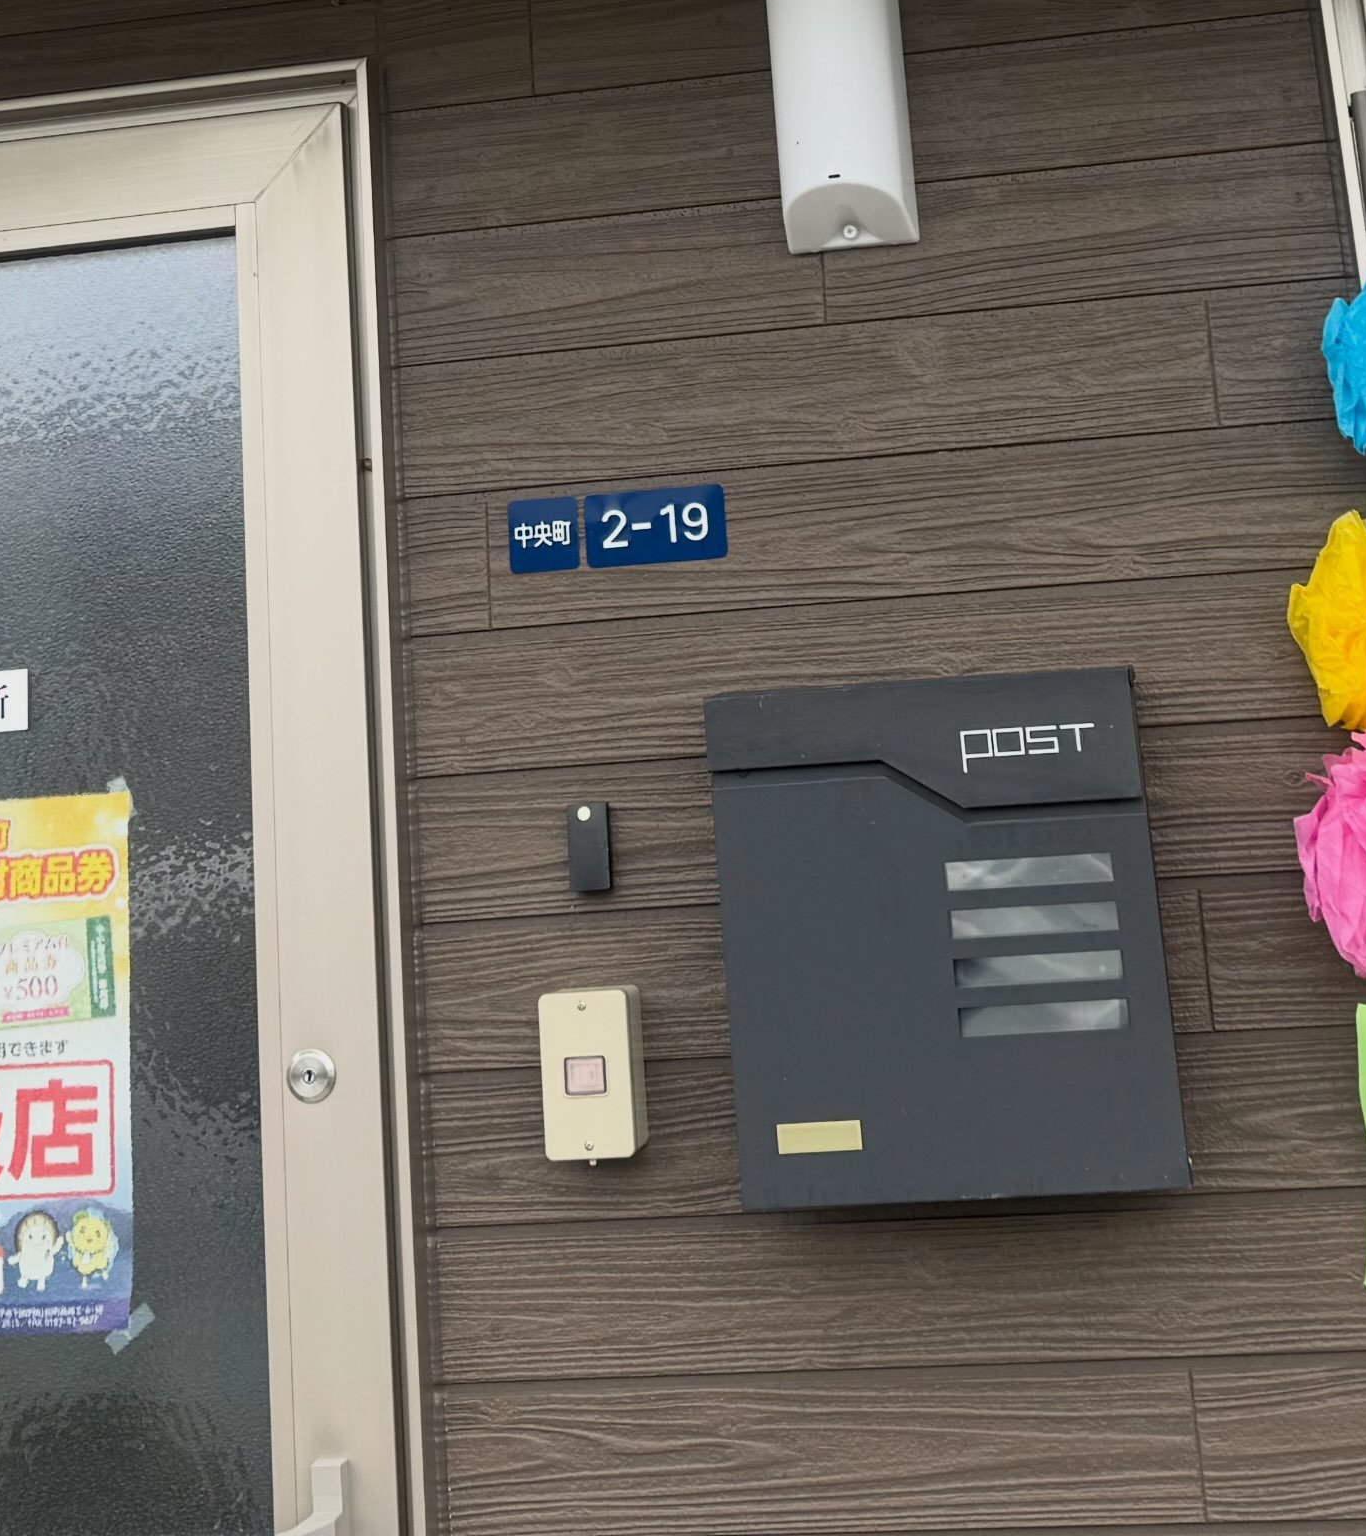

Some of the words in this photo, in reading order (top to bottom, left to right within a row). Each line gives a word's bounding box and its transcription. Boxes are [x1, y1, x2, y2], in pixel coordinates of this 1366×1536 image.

[513, 519, 573, 549] 中央町
[600, 501, 710, 550] 2-19
[959, 721, 1096, 774] POST
